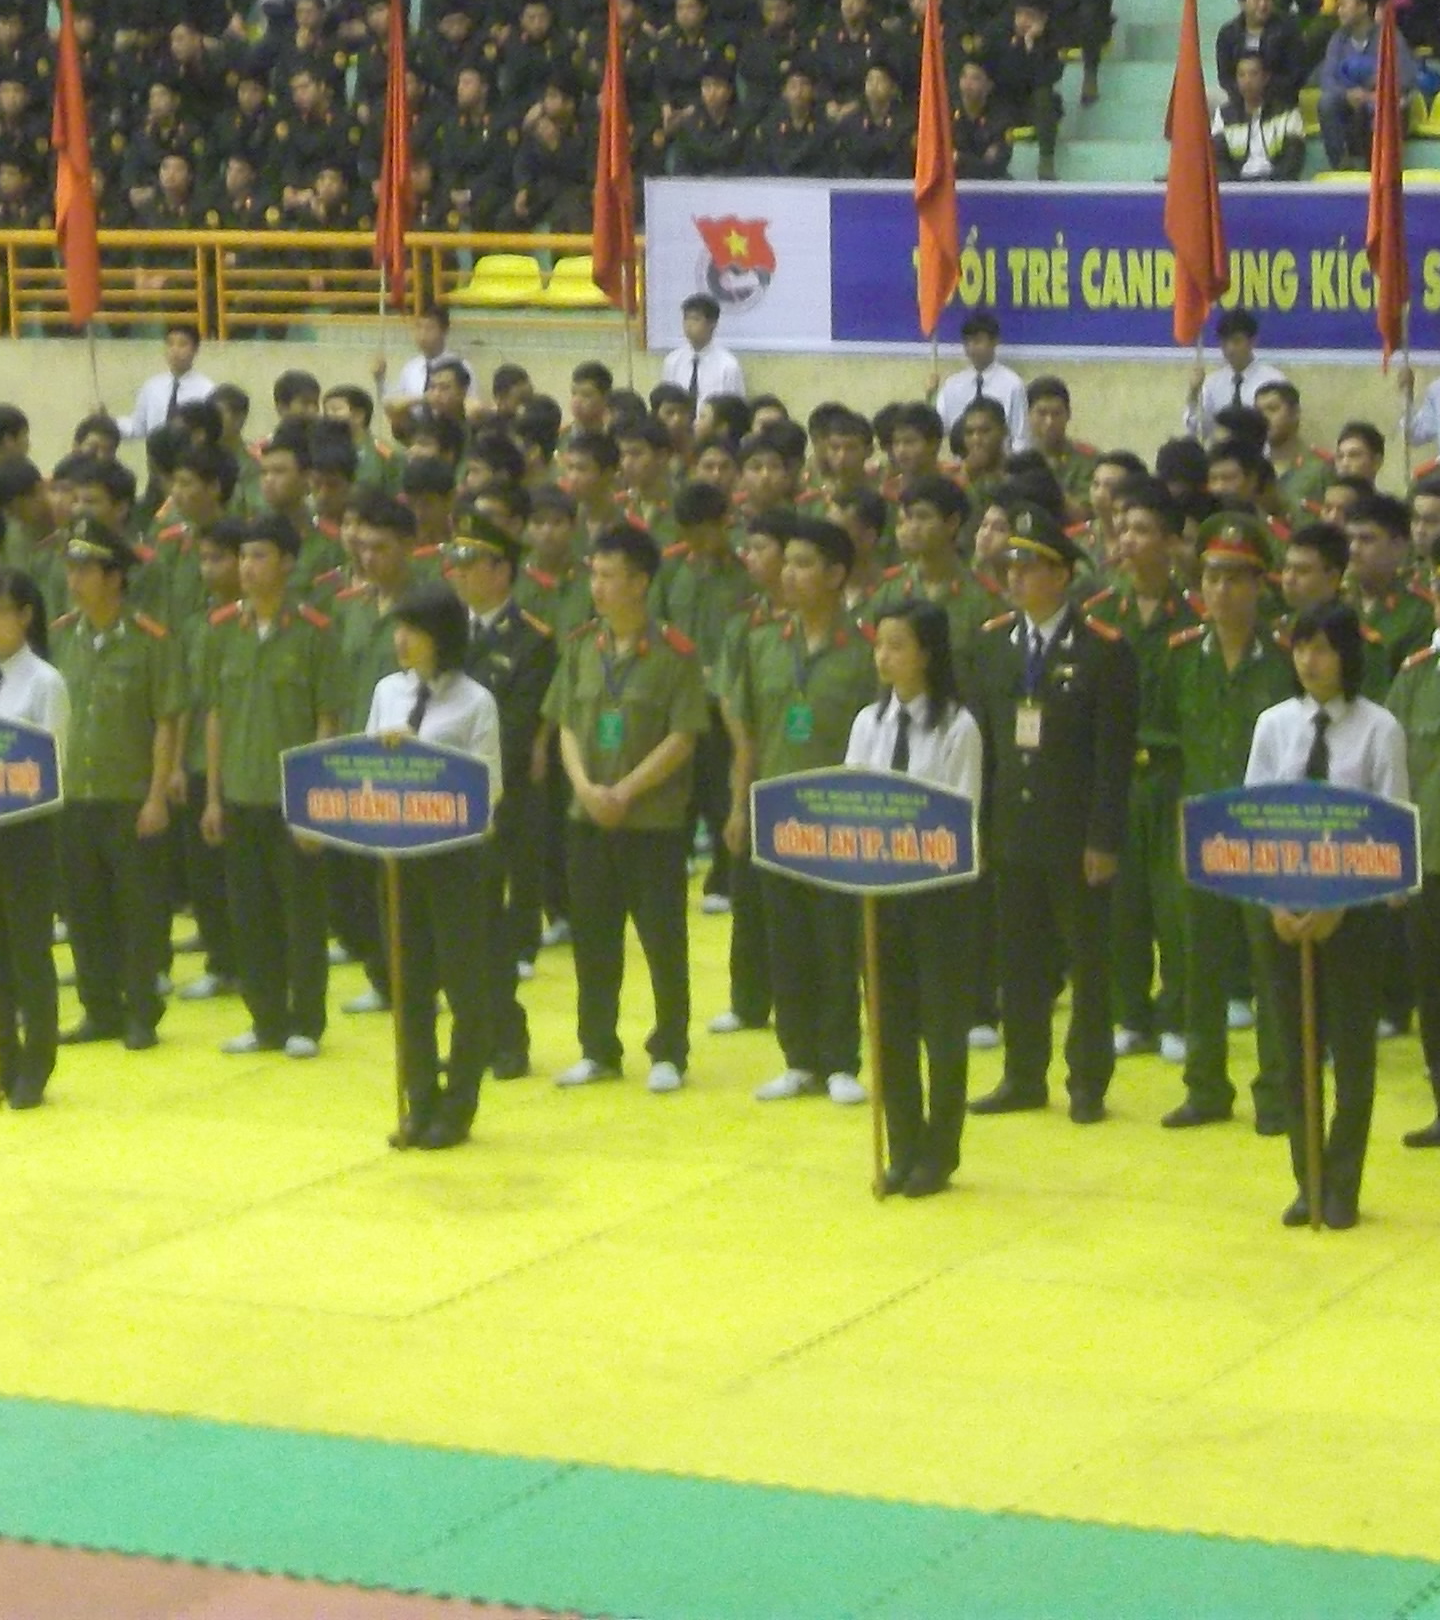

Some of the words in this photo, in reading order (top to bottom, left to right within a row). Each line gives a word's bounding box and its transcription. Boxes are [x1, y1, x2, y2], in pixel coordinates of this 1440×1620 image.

[1007, 230, 1071, 309] TRẺ
[1080, 247, 1177, 310] CAND
[1310, 234, 1381, 311] KÍC
